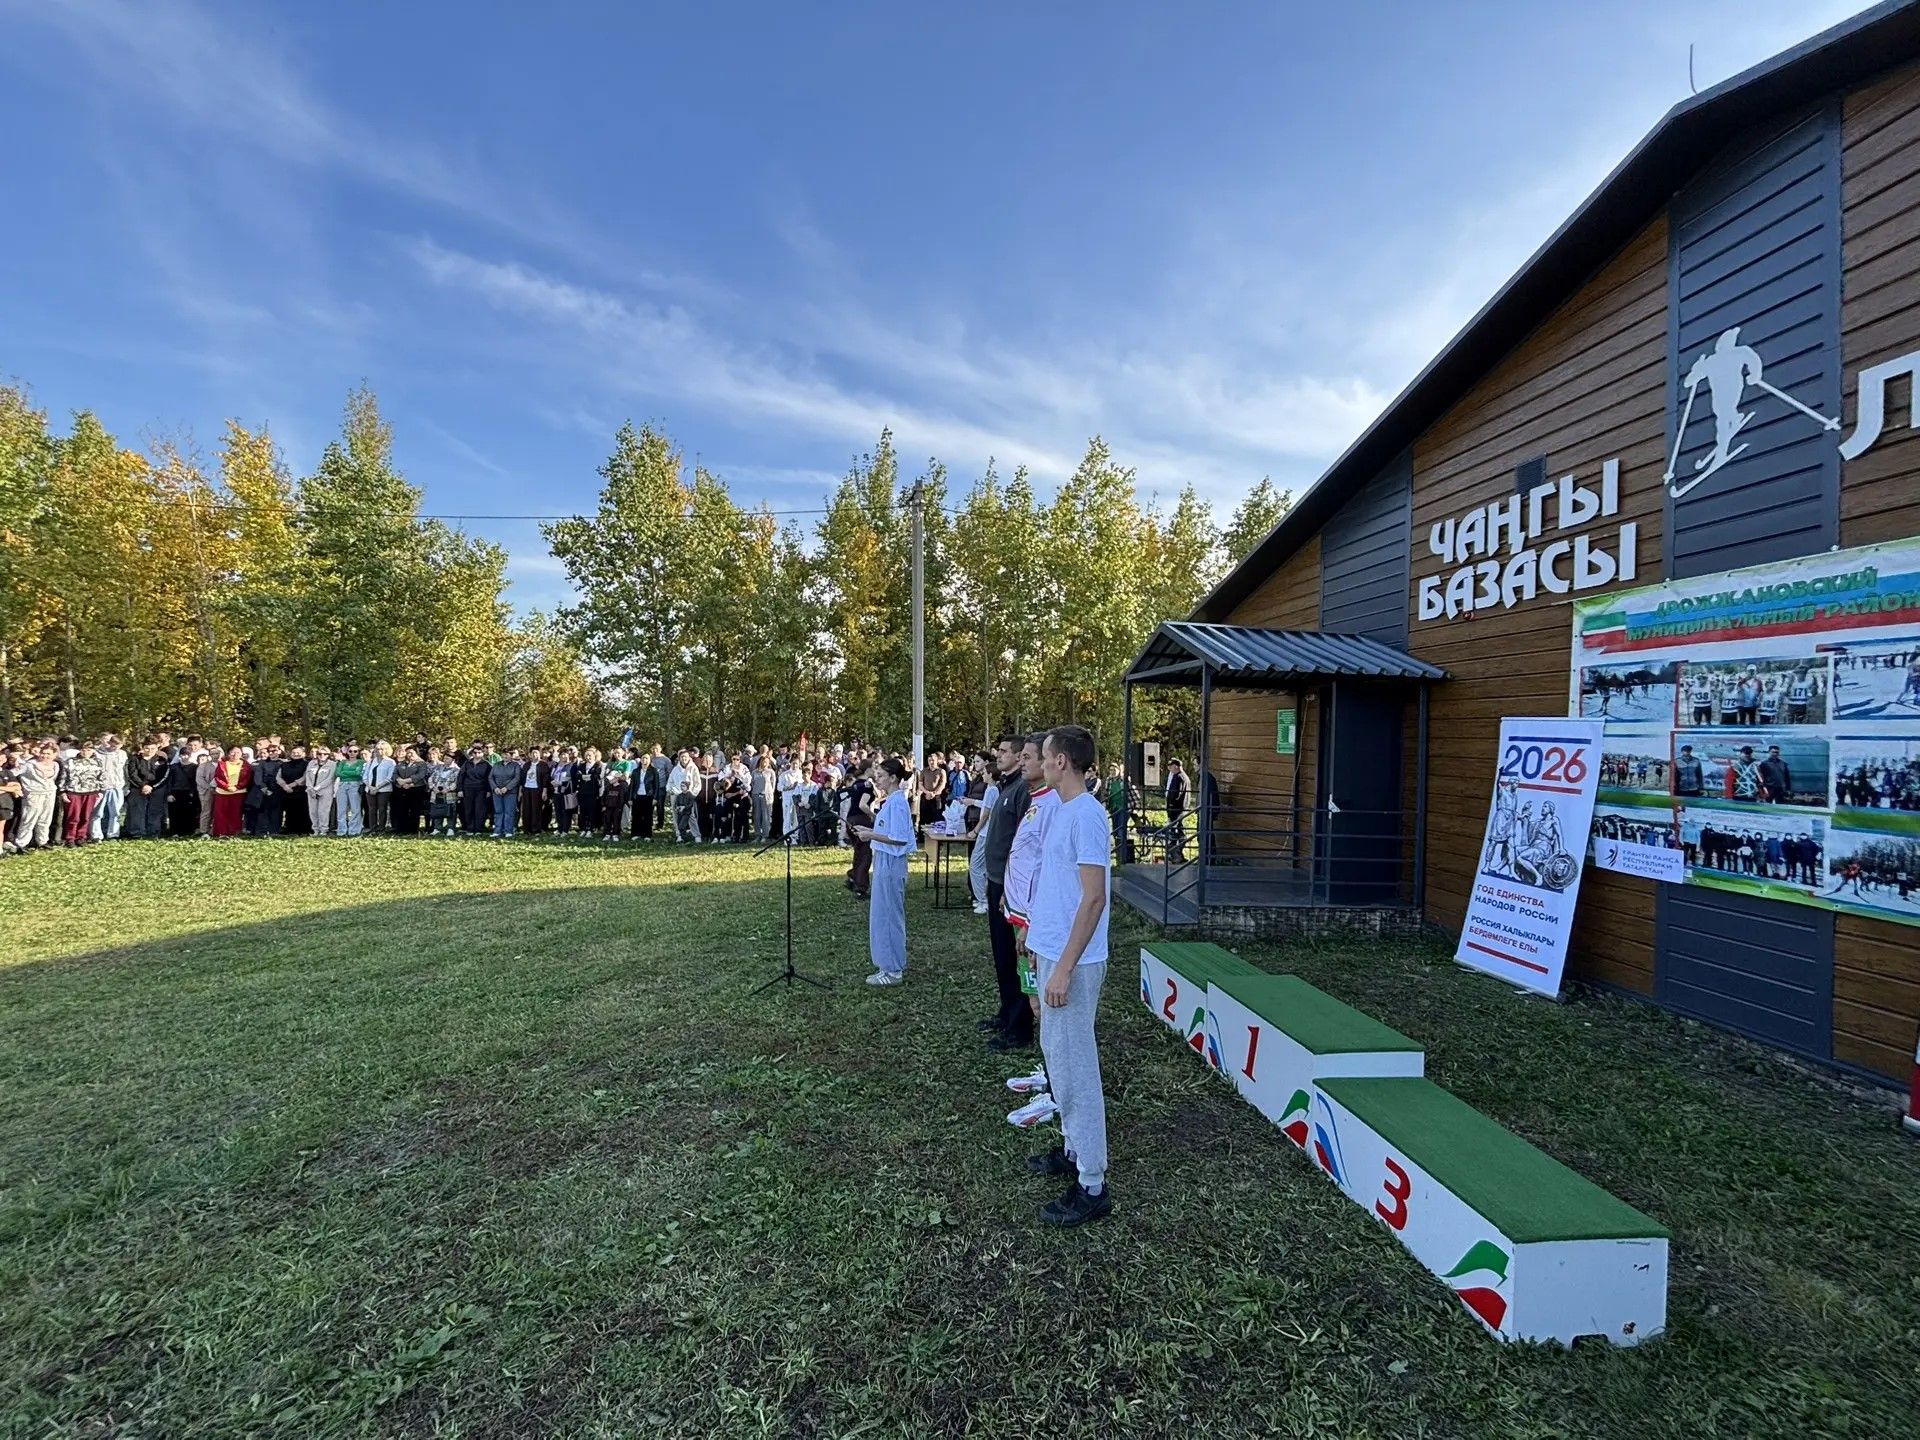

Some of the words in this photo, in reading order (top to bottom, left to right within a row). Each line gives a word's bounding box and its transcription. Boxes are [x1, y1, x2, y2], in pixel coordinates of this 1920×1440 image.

[1429, 458, 1619, 564] ЧАҢГЫ
[1418, 522, 1636, 621] БАЗАСЫ
[1656, 566, 1879, 617] ДРОЖЖАНОВСКИЙ
[1626, 601, 1814, 641] МУНИЦИПАЛЬНЫЙ
[1503, 745, 1587, 784] 2026
[1475, 895, 1516, 912] НАРОДОВ
[1519, 907, 1559, 925] РОССИИ
[1477, 884, 1495, 895] ГОД
[1496, 889, 1545, 908] ЕДИНСТВА
[1469, 926, 1518, 947] БЕРДӘМЛЕГЕ
[1519, 941, 1538, 954] ЕЛЫ
[1471, 915, 1502, 930] РОССИЯ
[1502, 924, 1555, 947] ХАЛЫКЛАРЫ
[1164, 978, 1178, 1022] 2
[1241, 1025, 1260, 1082] 1
[1375, 1156, 1411, 1231] 3
